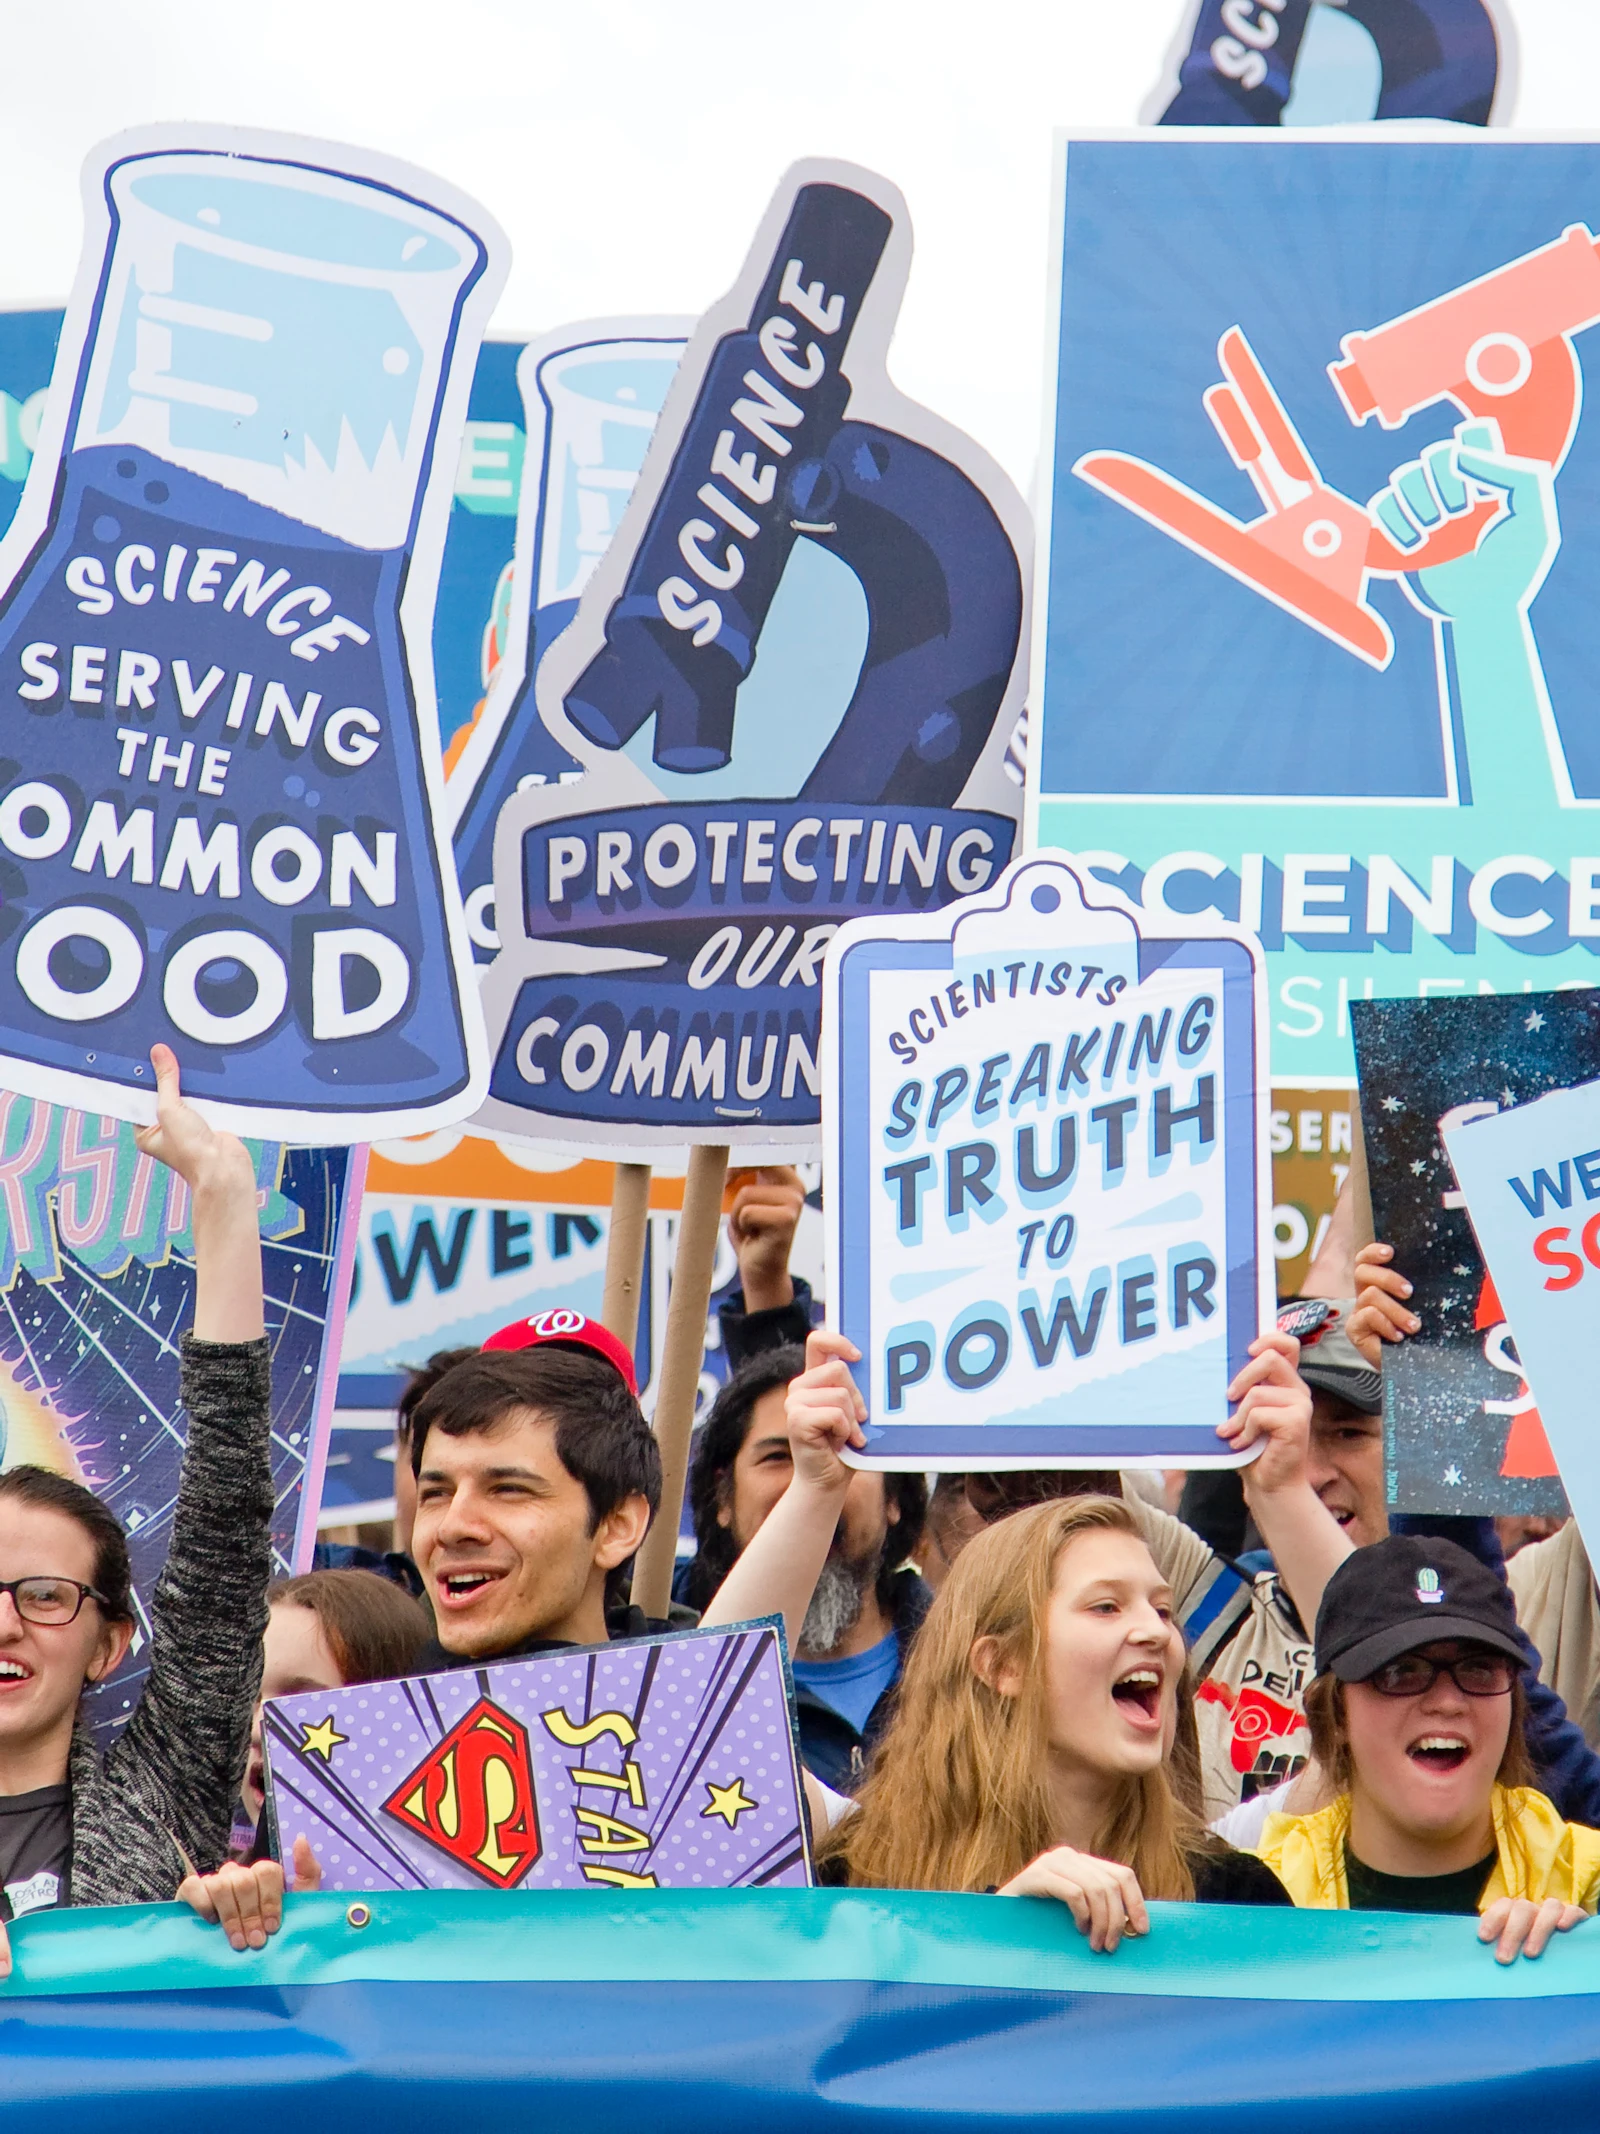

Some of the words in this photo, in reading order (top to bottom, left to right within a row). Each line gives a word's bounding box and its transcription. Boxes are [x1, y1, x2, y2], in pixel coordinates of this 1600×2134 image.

[656, 258, 845, 647] SCIENCE
[65, 543, 371, 662] SCIENCE
[17, 641, 381, 766] SERVING
[116, 728, 232, 796] THE
[548, 817, 996, 902] PROTECTING
[687, 923, 839, 991] OUR
[885, 996, 1216, 1141] SPEAKING
[889, 961, 1127, 1065] SCIENTISTS
[884, 1073, 1217, 1232] TRUTH
[1019, 1213, 1075, 1270] TO
[528, 1309, 586, 1337] W
[887, 1258, 1217, 1411] POWER
